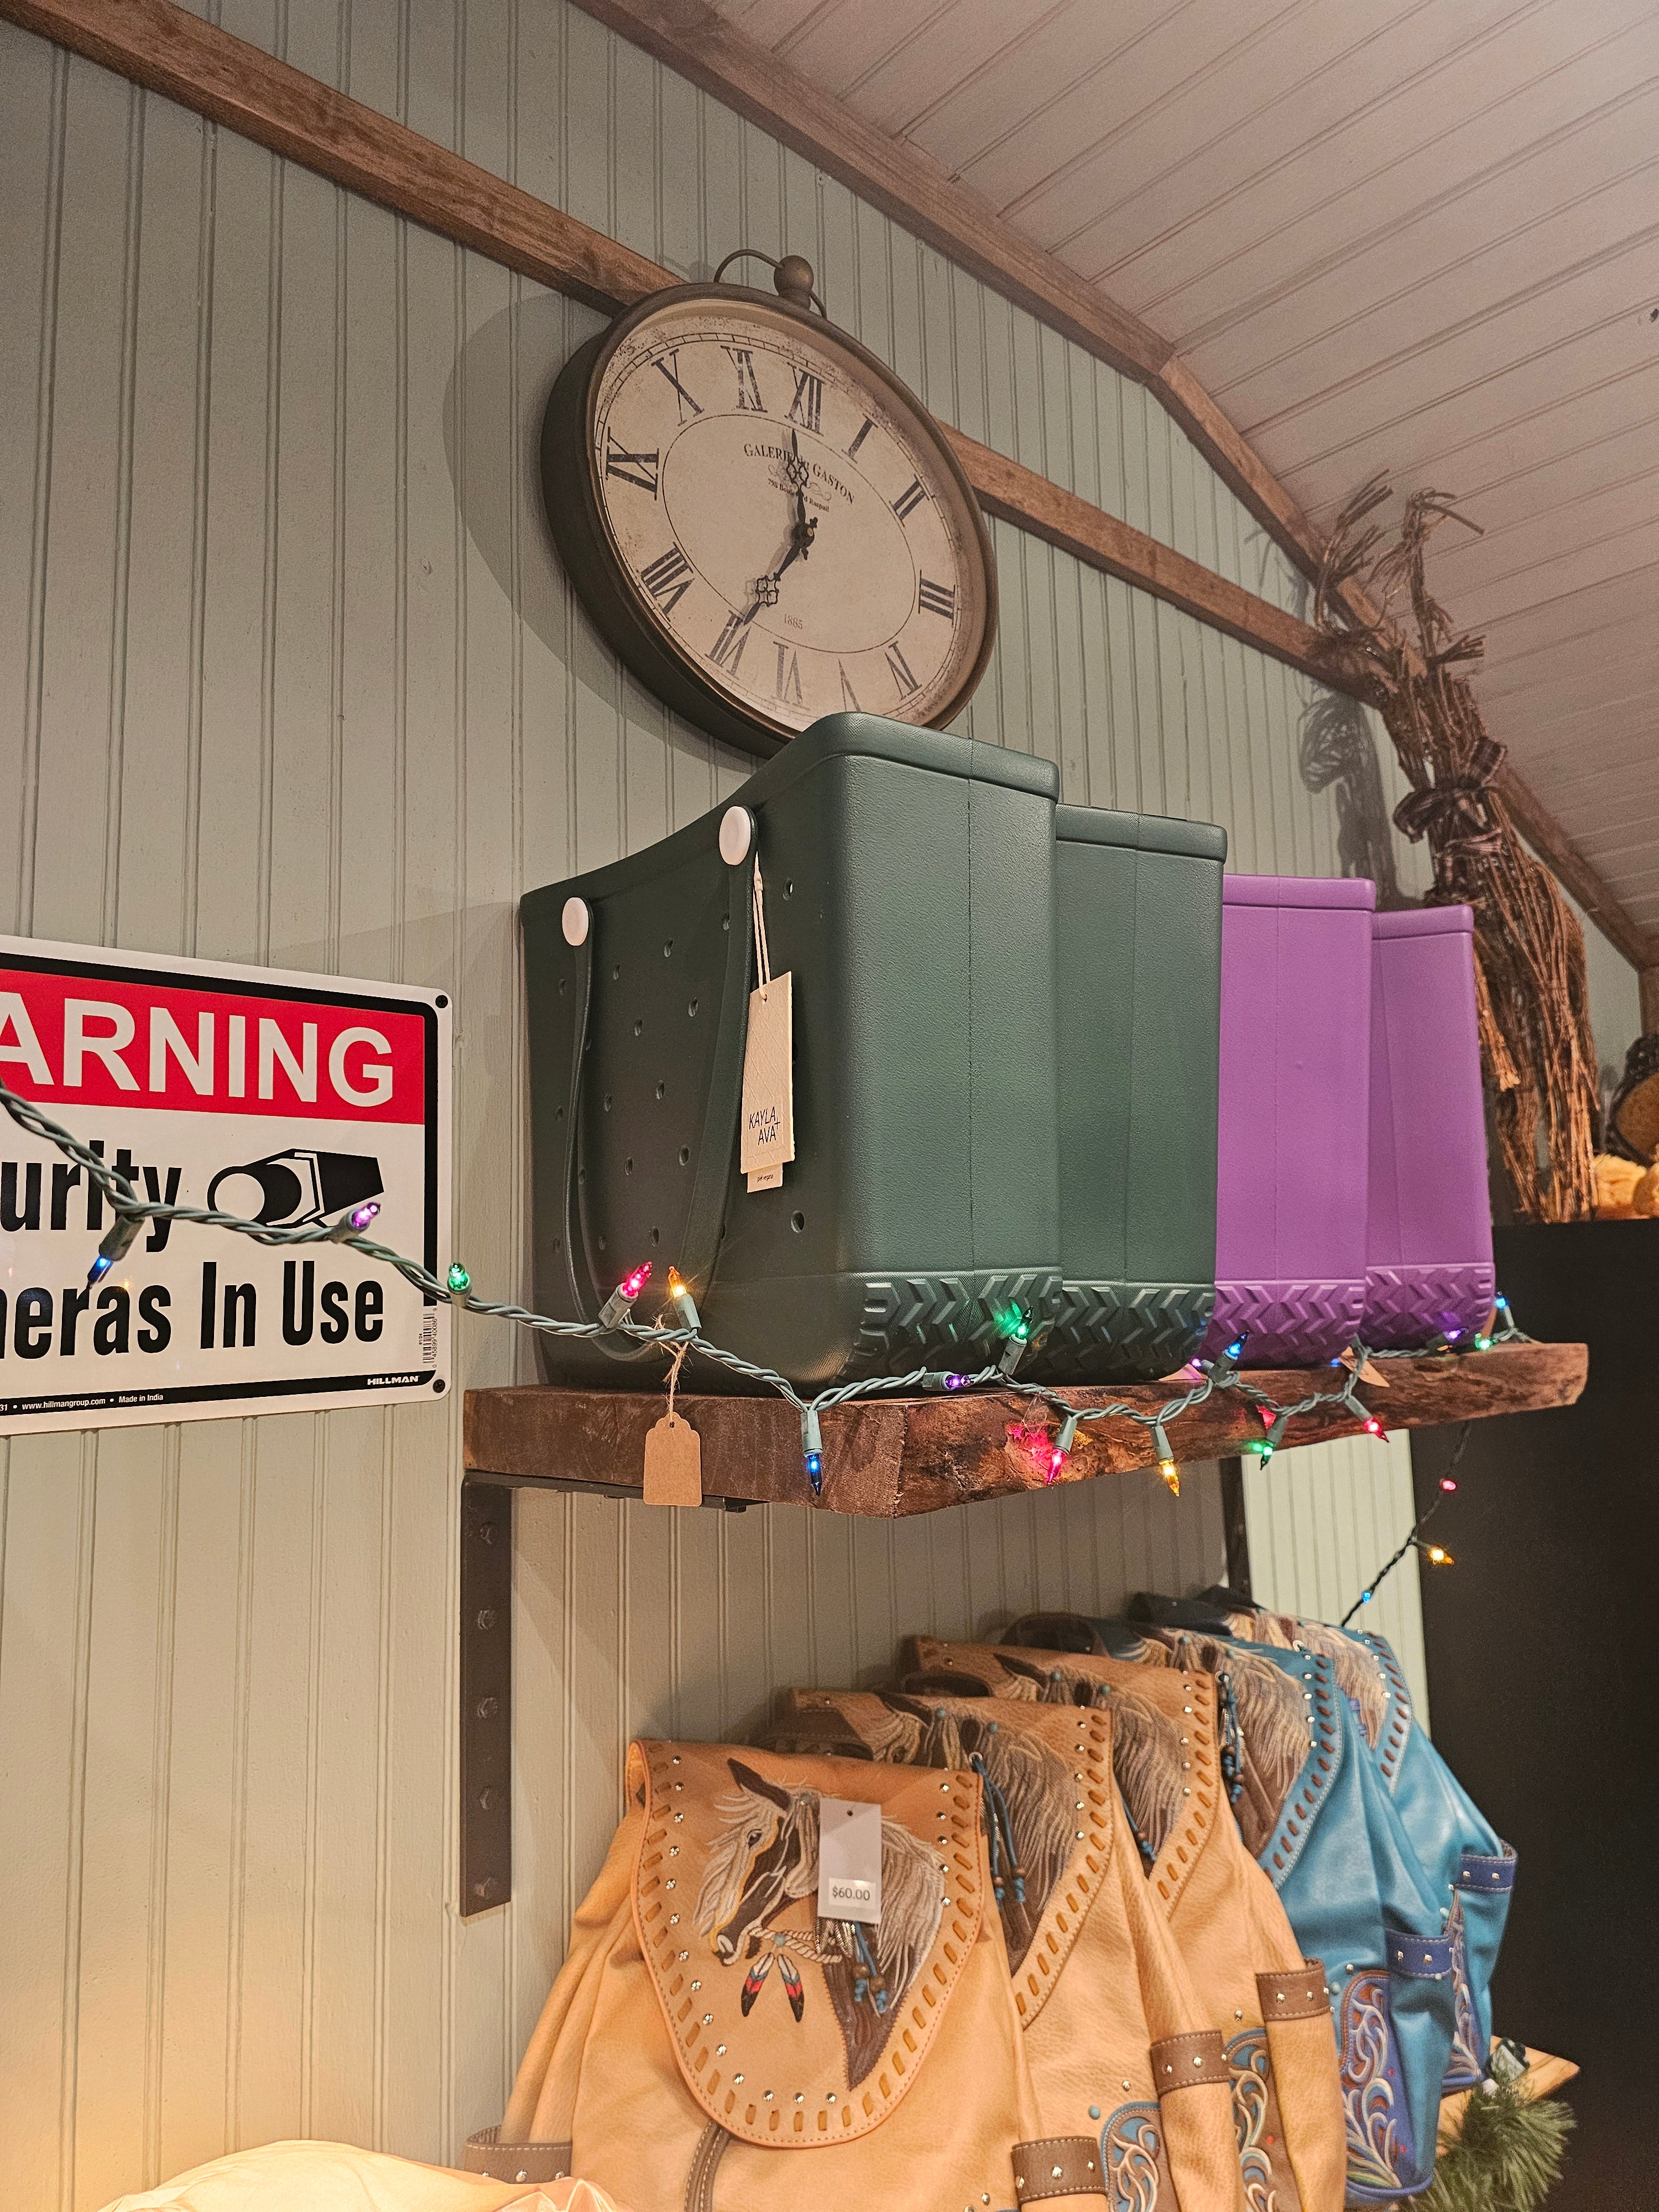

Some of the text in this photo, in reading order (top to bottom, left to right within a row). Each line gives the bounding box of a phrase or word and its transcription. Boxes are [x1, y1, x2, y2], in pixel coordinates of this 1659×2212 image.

[651, 348, 705, 426] X
[784, 362, 825, 436] XII
[605, 426, 659, 500] IX
[842, 413, 878, 463] I
[813, 463, 855, 504] GASTON
[889, 473, 930, 526] II
[640, 542, 696, 622] VIII
[918, 570, 956, 628] III
[705, 609, 752, 680] VII
[784, 614, 802, 629] 1885
[771, 641, 810, 711] VI
[0, 993, 393, 1107] ARNING
[749, 1106, 776, 1130] KAYLA
[758, 1126, 776, 1145] AVA
[1, 1140, 182, 1252] urity
[200, 1261, 257, 1349] In
[282, 1260, 383, 1346] Use
[22, 1397, 106, 1410] www.hillmangroup.com
[367, 1376, 419, 1385] HILLMAN
[832, 1885, 870, 1901] $60.00
